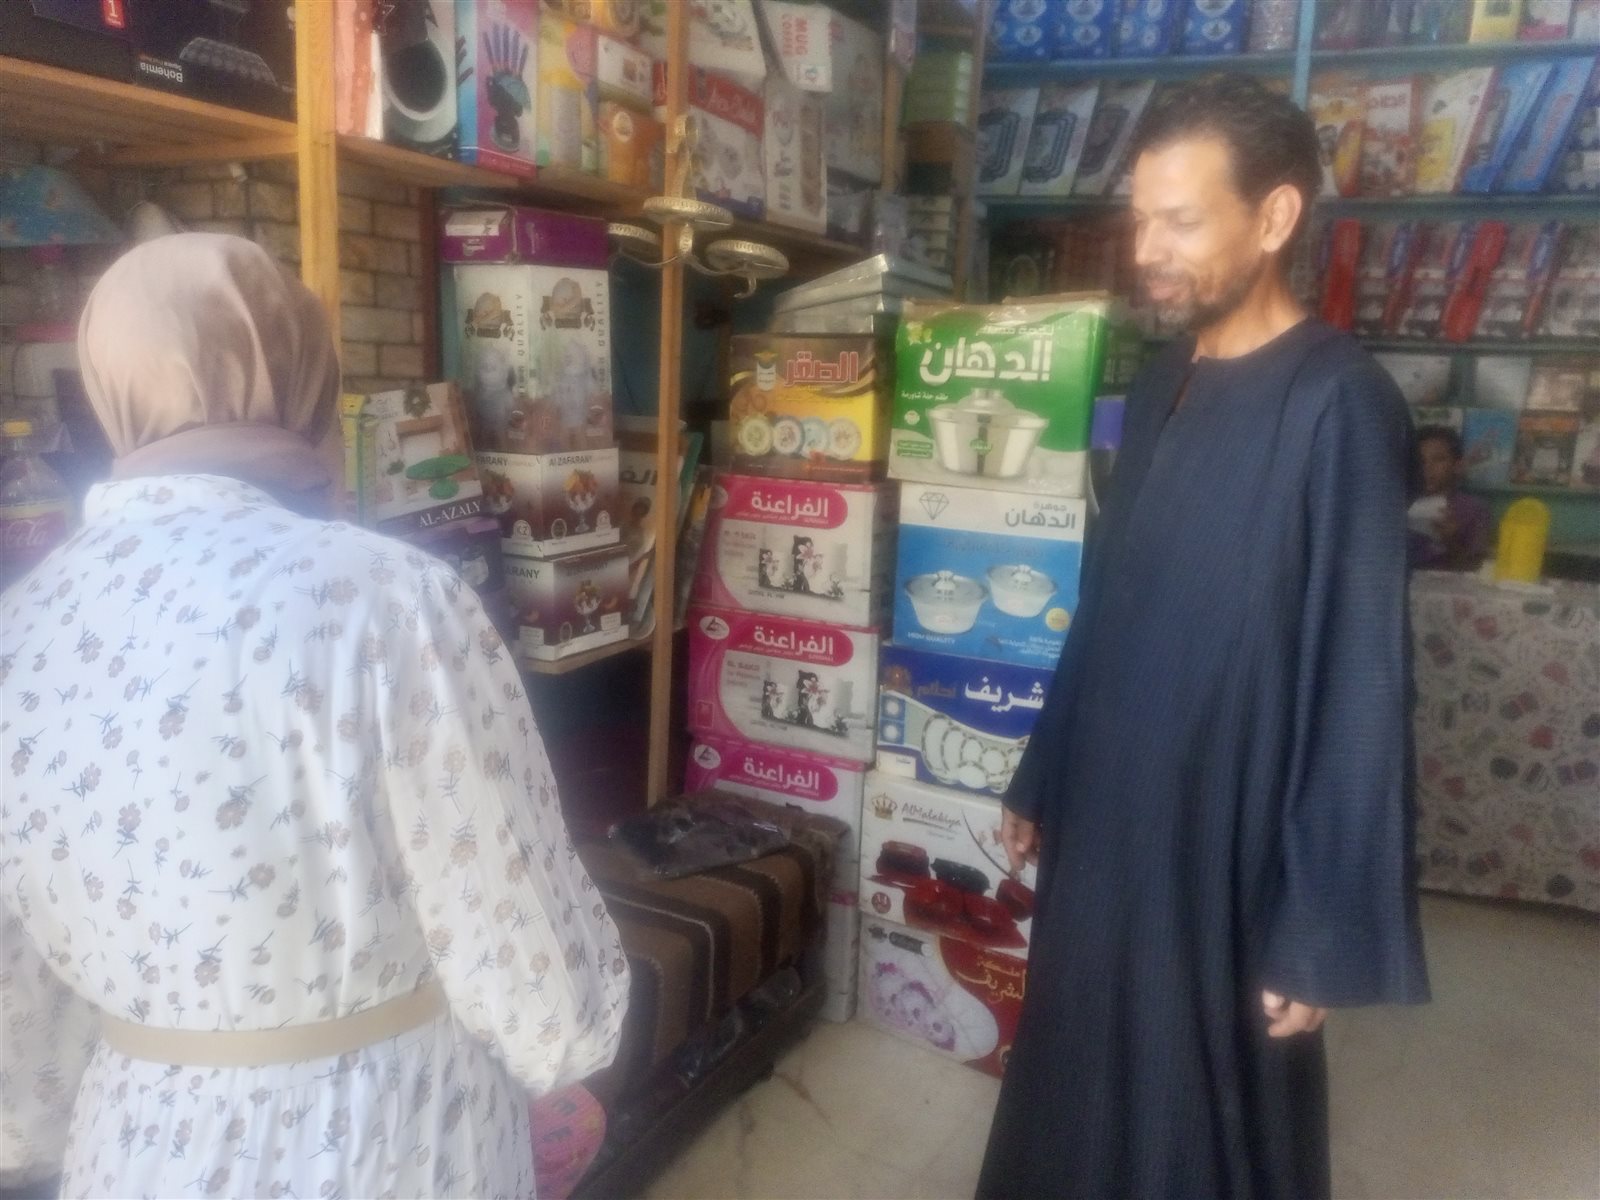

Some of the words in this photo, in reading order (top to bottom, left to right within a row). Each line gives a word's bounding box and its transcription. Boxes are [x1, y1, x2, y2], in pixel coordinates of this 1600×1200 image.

[140, 62, 183, 83] Bohemia
[516, 294, 526, 356] QUALITY
[595, 281, 605, 346] QUALITY
[783, 351, 859, 387] الصقر
[919, 337, 1053, 386] الدهان
[419, 500, 480, 528] AL-AZALY
[751, 490, 829, 521] الفراعنة
[1005, 508, 1076, 530] الدهان
[754, 625, 834, 656] الفراعنة
[965, 676, 1044, 712] شريف
[744, 756, 820, 790] الفراعنة
